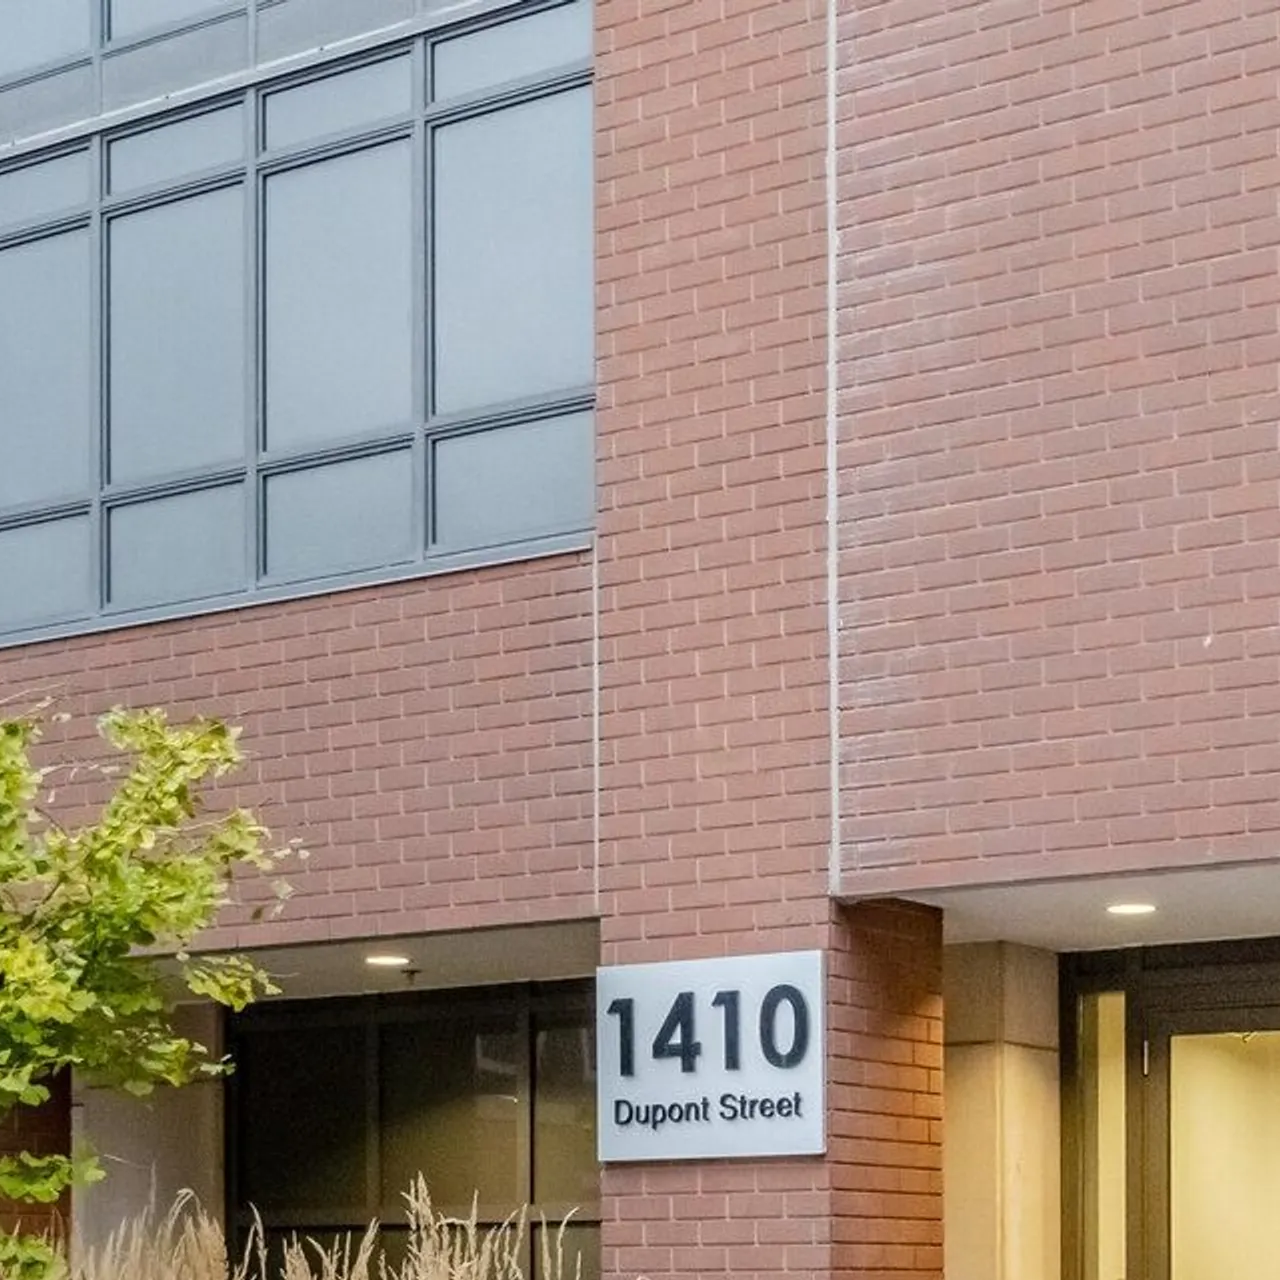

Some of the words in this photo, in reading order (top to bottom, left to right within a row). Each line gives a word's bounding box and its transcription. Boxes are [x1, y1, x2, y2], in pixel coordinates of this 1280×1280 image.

[607, 984, 808, 1076] 1410
[614, 1097, 709, 1129] Dupont
[719, 1092, 802, 1120] Street
